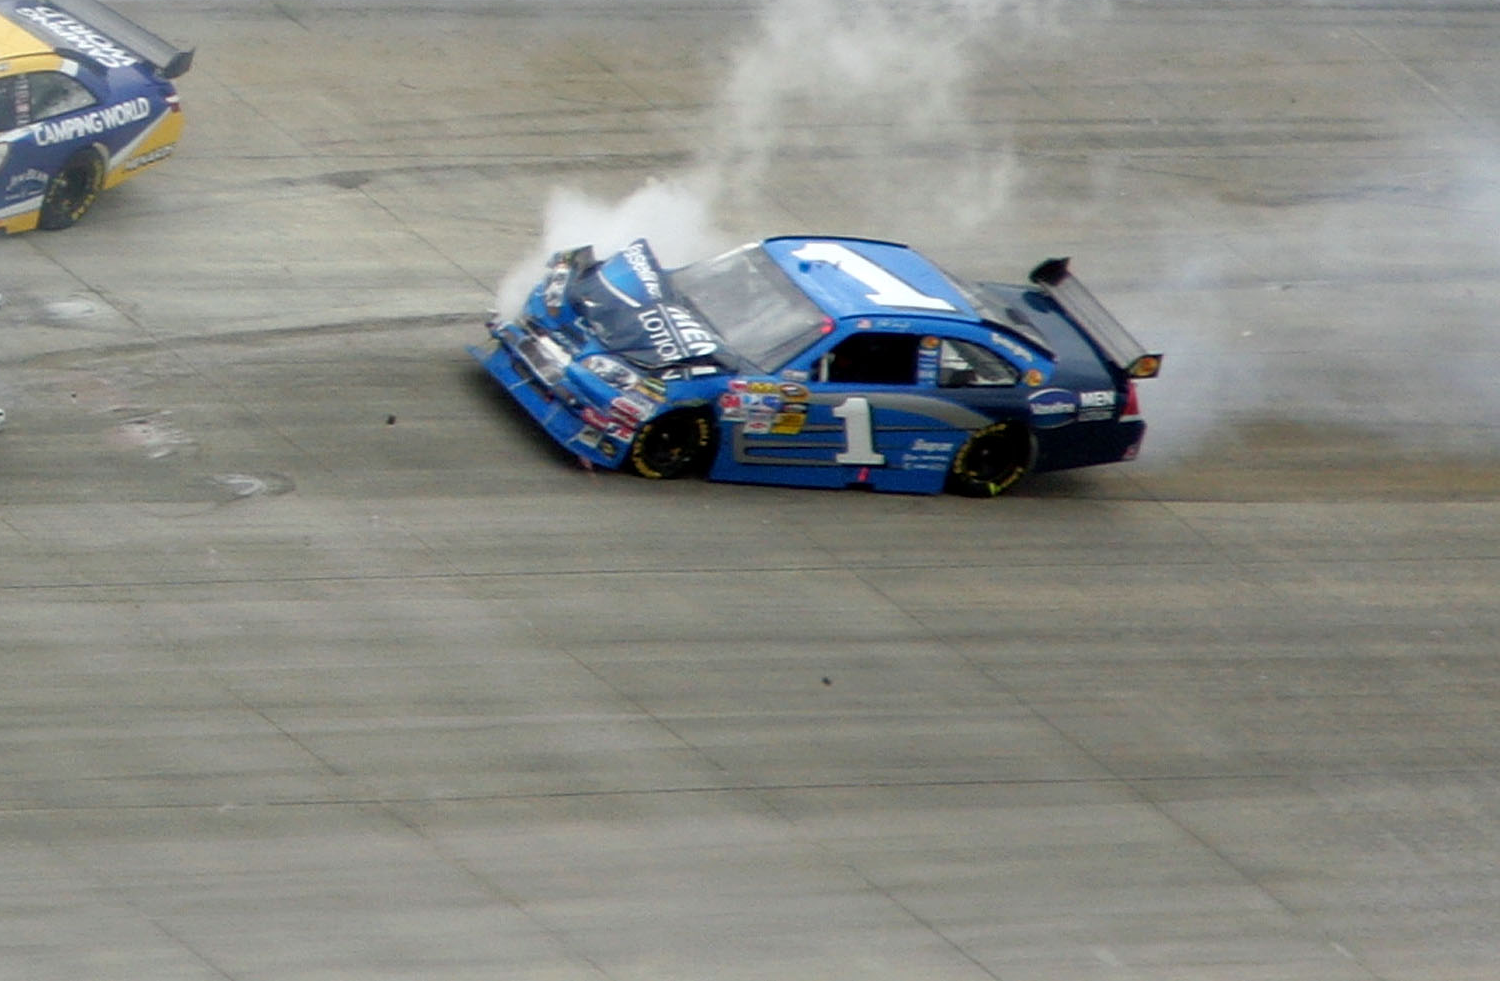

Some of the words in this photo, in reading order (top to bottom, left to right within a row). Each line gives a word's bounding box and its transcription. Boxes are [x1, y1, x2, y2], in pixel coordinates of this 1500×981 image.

[33, 112, 104, 147] CAMPING
[100, 97, 150, 130] WORLD
[790, 242, 956, 311] 1
[832, 397, 885, 464] 1
